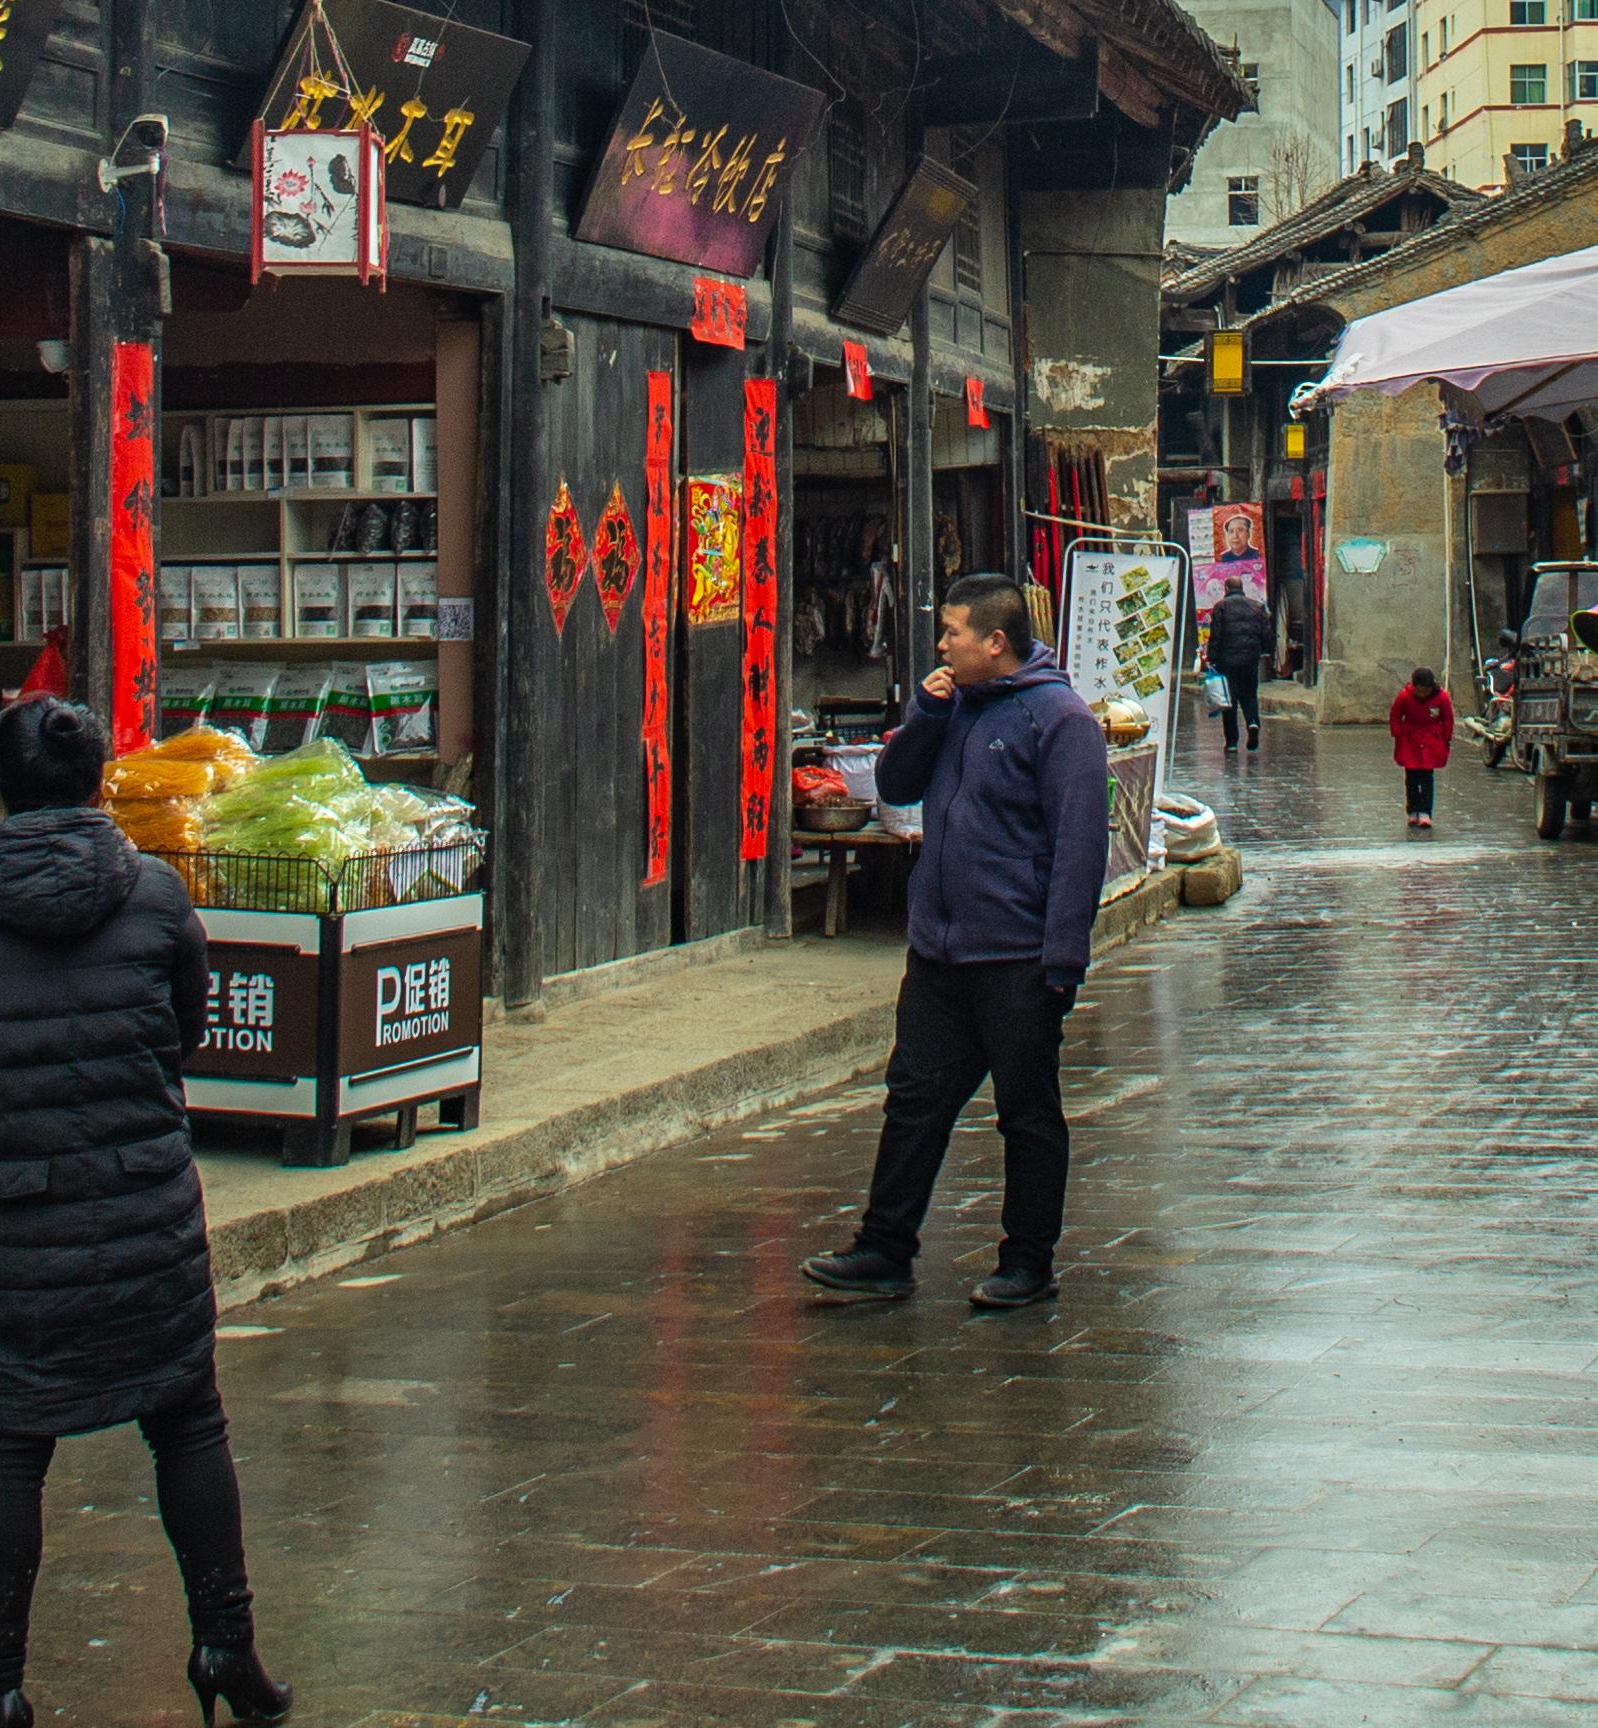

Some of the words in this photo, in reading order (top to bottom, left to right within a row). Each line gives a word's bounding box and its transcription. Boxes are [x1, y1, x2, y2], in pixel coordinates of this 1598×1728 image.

[1093, 562, 1115, 689] 我们只代表柞水
[404, 957, 451, 1016] 促销
